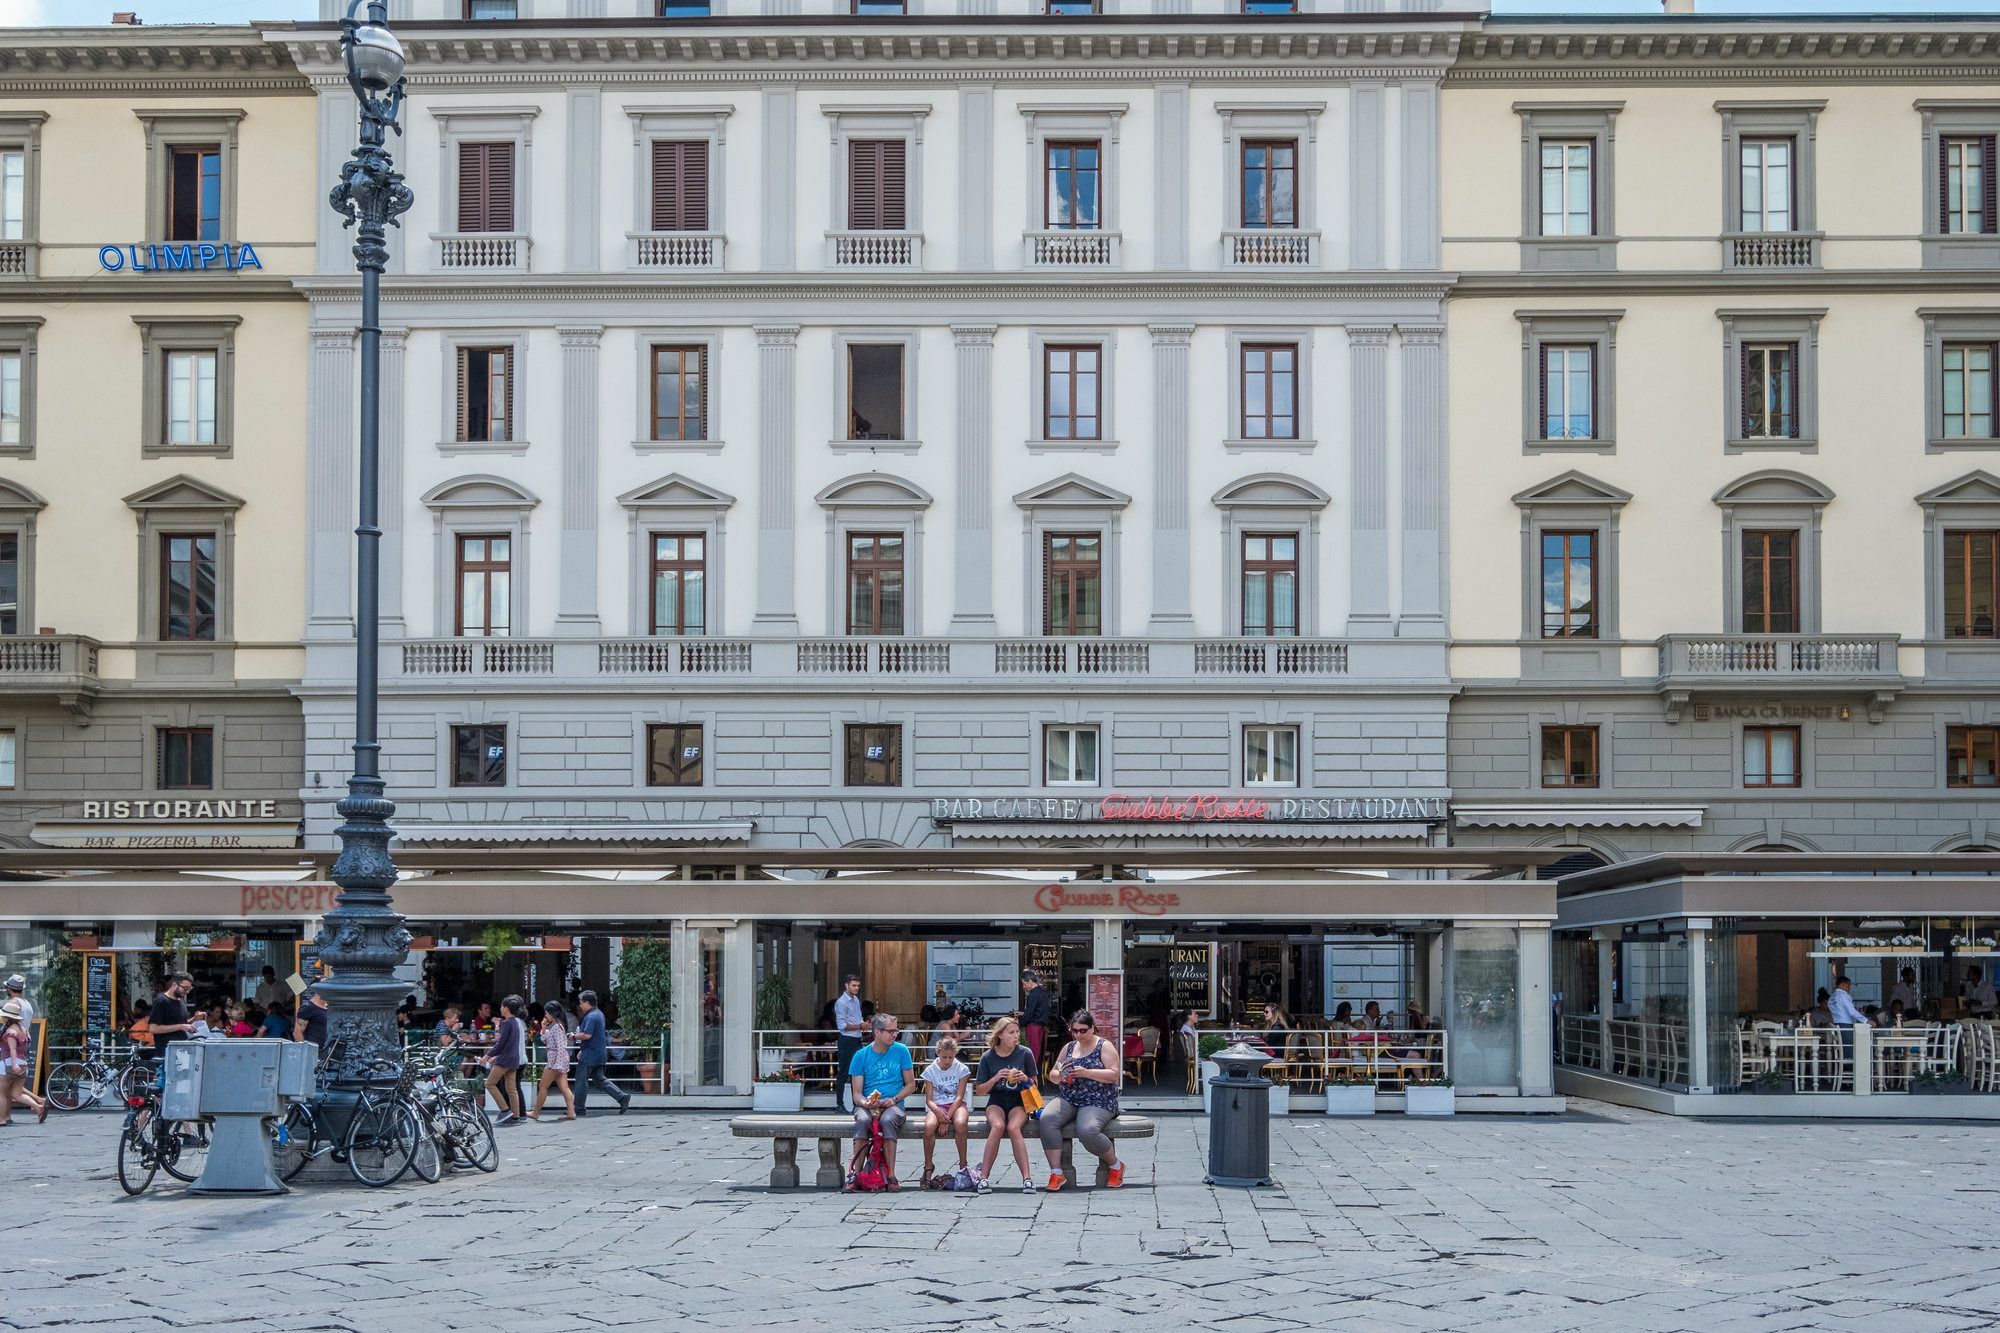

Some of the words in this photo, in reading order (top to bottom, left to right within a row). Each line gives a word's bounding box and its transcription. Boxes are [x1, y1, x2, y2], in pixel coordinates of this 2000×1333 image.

[99, 243, 263, 271] OLIMPIA
[488, 746, 504, 757] EF
[683, 747, 699, 757] EF
[867, 746, 883, 757] EF
[83, 800, 276, 819] RISTORANTE
[933, 798, 984, 819] BAR
[1282, 797, 1447, 820] RESTAURANT
[85, 836, 116, 847] BAR
[127, 835, 199, 847] PIZZERIA
[209, 835, 241, 846] BAR
[1178, 981, 1204, 990] UNCH
